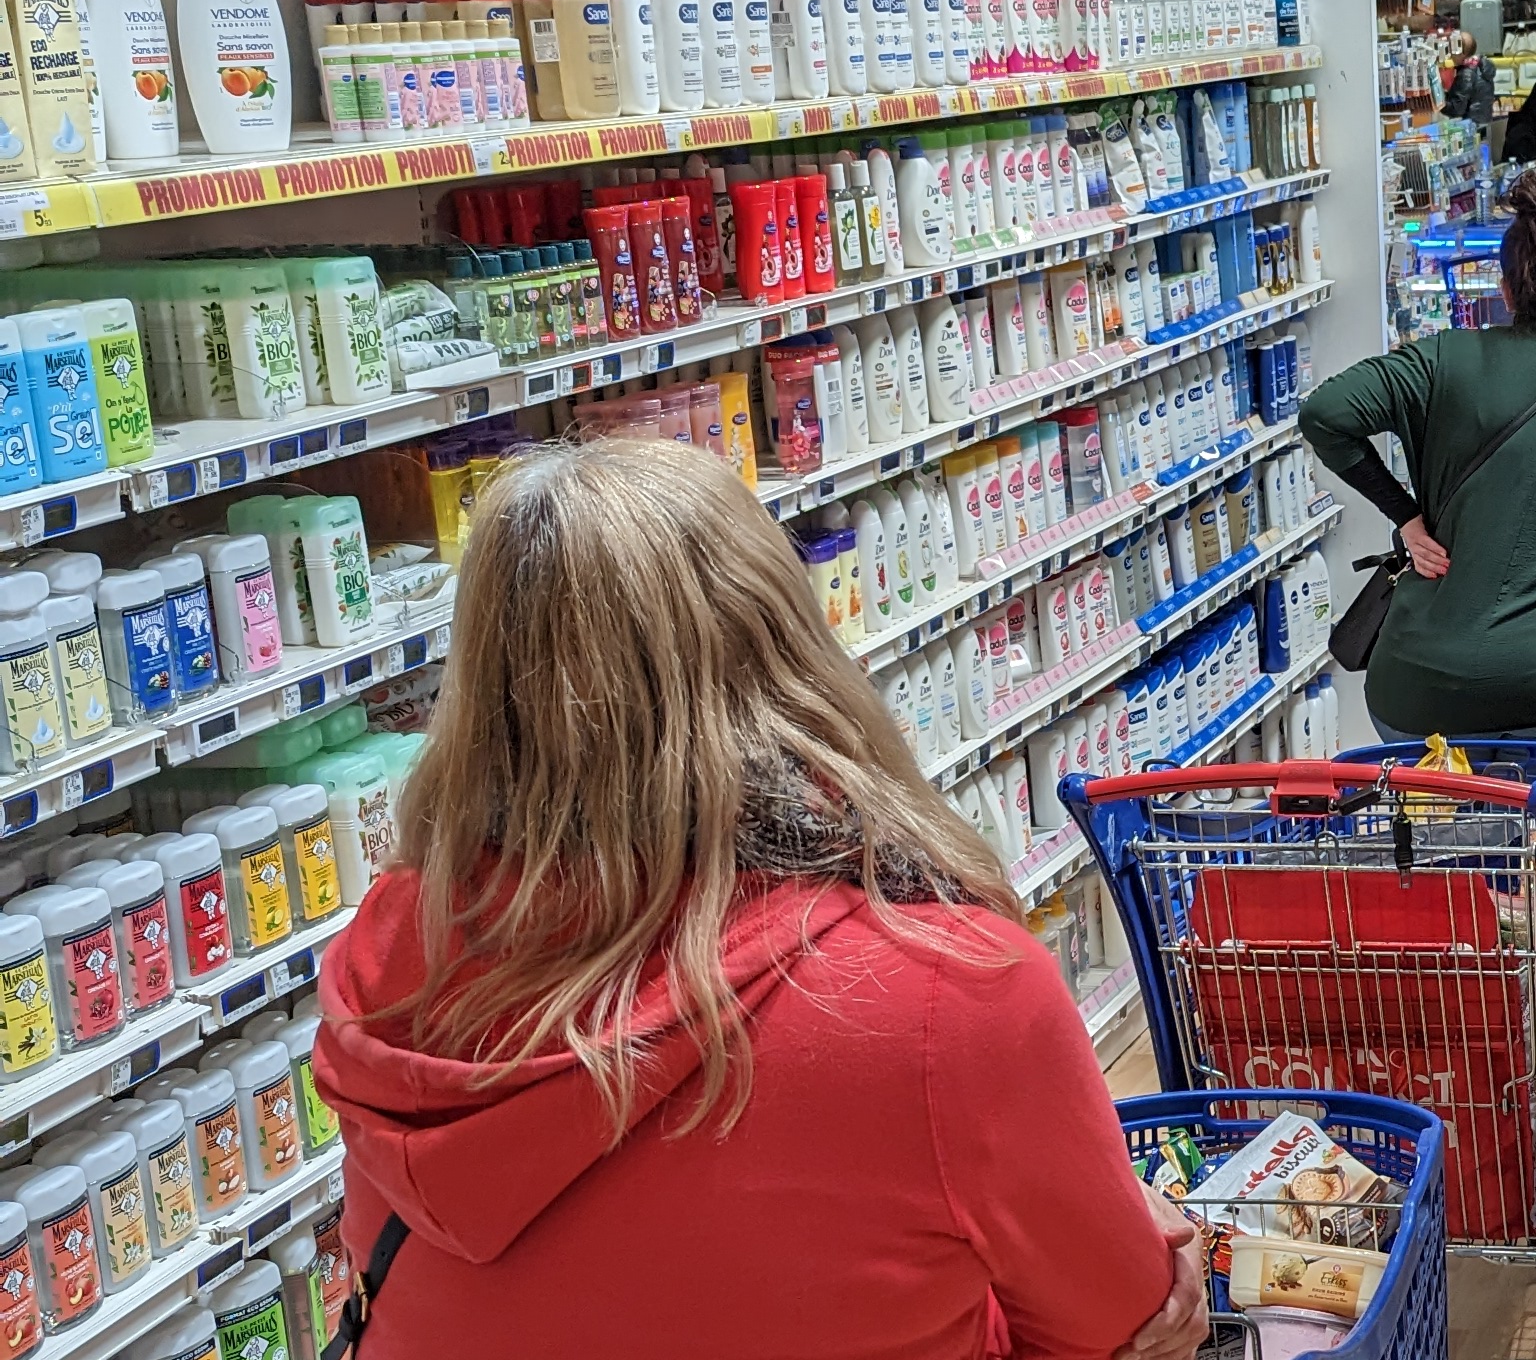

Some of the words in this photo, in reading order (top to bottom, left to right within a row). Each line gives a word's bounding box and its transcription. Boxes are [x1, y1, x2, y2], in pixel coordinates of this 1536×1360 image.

[210, 8, 269, 20] VENDOME
[31, 39, 48, 52] ECO
[131, 45, 151, 54] Sans
[217, 41, 244, 51] Sans
[245, 43, 274, 51] savon
[240, 52, 274, 60] SENSIBLES
[31, 51, 80, 70] RECHARGE
[506, 130, 594, 167] PROMOTION
[136, 168, 266, 216] PROMOTION
[275, 152, 386, 200] PROMOTION
[355, 330, 378, 350] BIO
[941, 329, 959, 341] Dove
[44, 348, 86, 377] MARSEILLAIS
[101, 339, 136, 366] MARSEILLAIS
[266, 343, 291, 361] BIO
[71, 408, 91, 421] Grain
[108, 407, 149, 442] POIRE
[49, 407, 101, 455] Sel
[243, 578, 274, 598] MARSEILLAIS
[343, 571, 364, 592] BIO
[173, 594, 207, 616] MARSEILLAIS
[130, 613, 166, 633] MARSEILLAIS
[66, 633, 97, 661] MARSEILLAIS
[10, 654, 48, 681] MARSEILLAIS
[1129, 710, 1147, 722] Sanex
[367, 831, 391, 851] BIO
[249, 849, 281, 871] MARSEILLAIS
[132, 906, 165, 930] MARSEILLAIS
[72, 931, 112, 961] MARSEILLAIS
[2, 962, 43, 993] MARSEILLAIS
[204, 1115, 237, 1139] MARSEILLAIS
[1231, 1125, 1317, 1204] utella
[109, 1179, 141, 1203] MARSEILLAIS
[52, 1211, 88, 1237] MARSEILLAIS
[1320, 1271, 1348, 1288] Eskiss
[220, 1309, 246, 1323] FORMAT
[223, 1311, 278, 1352] MARSEILLAIS
